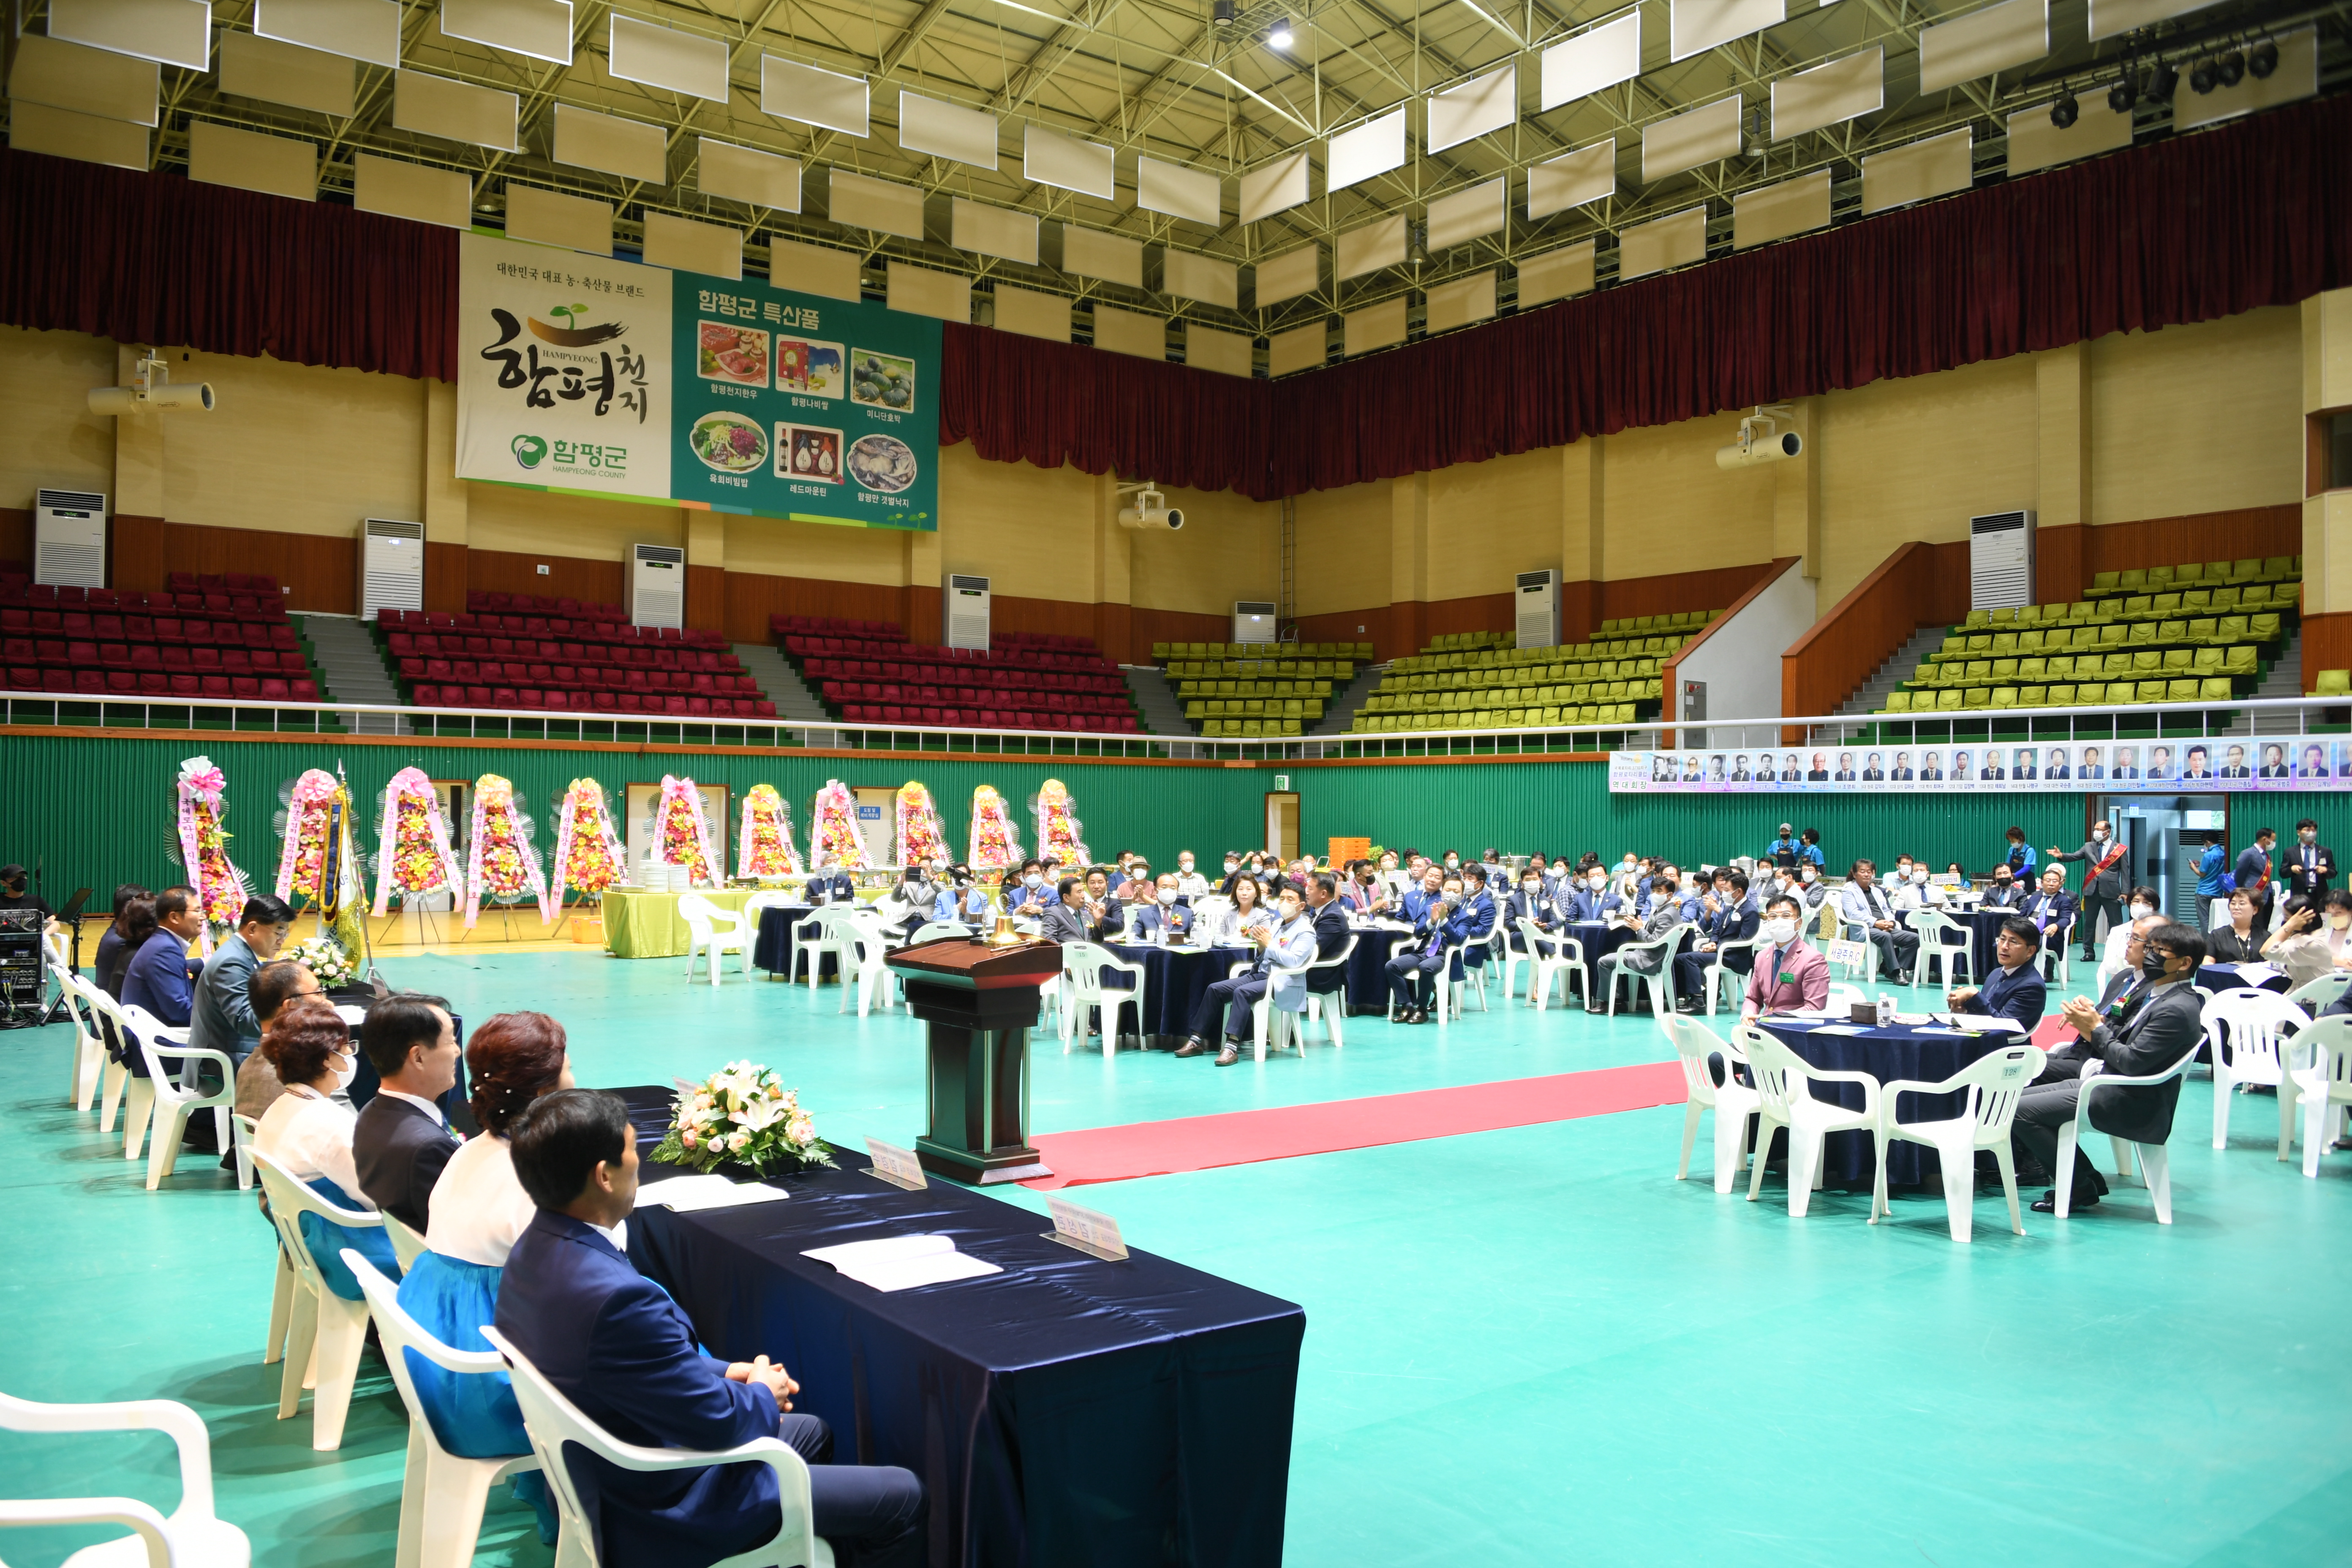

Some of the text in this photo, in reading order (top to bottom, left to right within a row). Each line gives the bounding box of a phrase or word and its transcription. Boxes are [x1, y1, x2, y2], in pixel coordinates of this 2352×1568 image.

[497, 263, 539, 280] 대한민국
[542, 271, 562, 283] 대표
[615, 284, 645, 297] 브랜드
[699, 290, 819, 330] 함평군 특산품
[543, 350, 598, 364] HAMPYEONG
[615, 344, 649, 425] 천지
[710, 383, 757, 399] 함평천지한우
[791, 397, 829, 410] 함평나비쌀
[866, 410, 901, 423] 미니단호박
[553, 440, 627, 470] 함평군
[553, 466, 626, 479] HAMPYEONG COUNTY
[709, 474, 748, 487] 육회비빔밥
[789, 484, 827, 496] 레드마운틴
[858, 492, 909, 508] 함평만 갯벌낙지
[1613, 781, 1647, 789] 역대회장
[181, 798, 194, 841] 국제로타리
[505, 804, 517, 822] 회장
[558, 851, 565, 866] 대표
[1831, 948, 1860, 961] 서광주 R.C
[2004, 1068, 2017, 1076] 128
